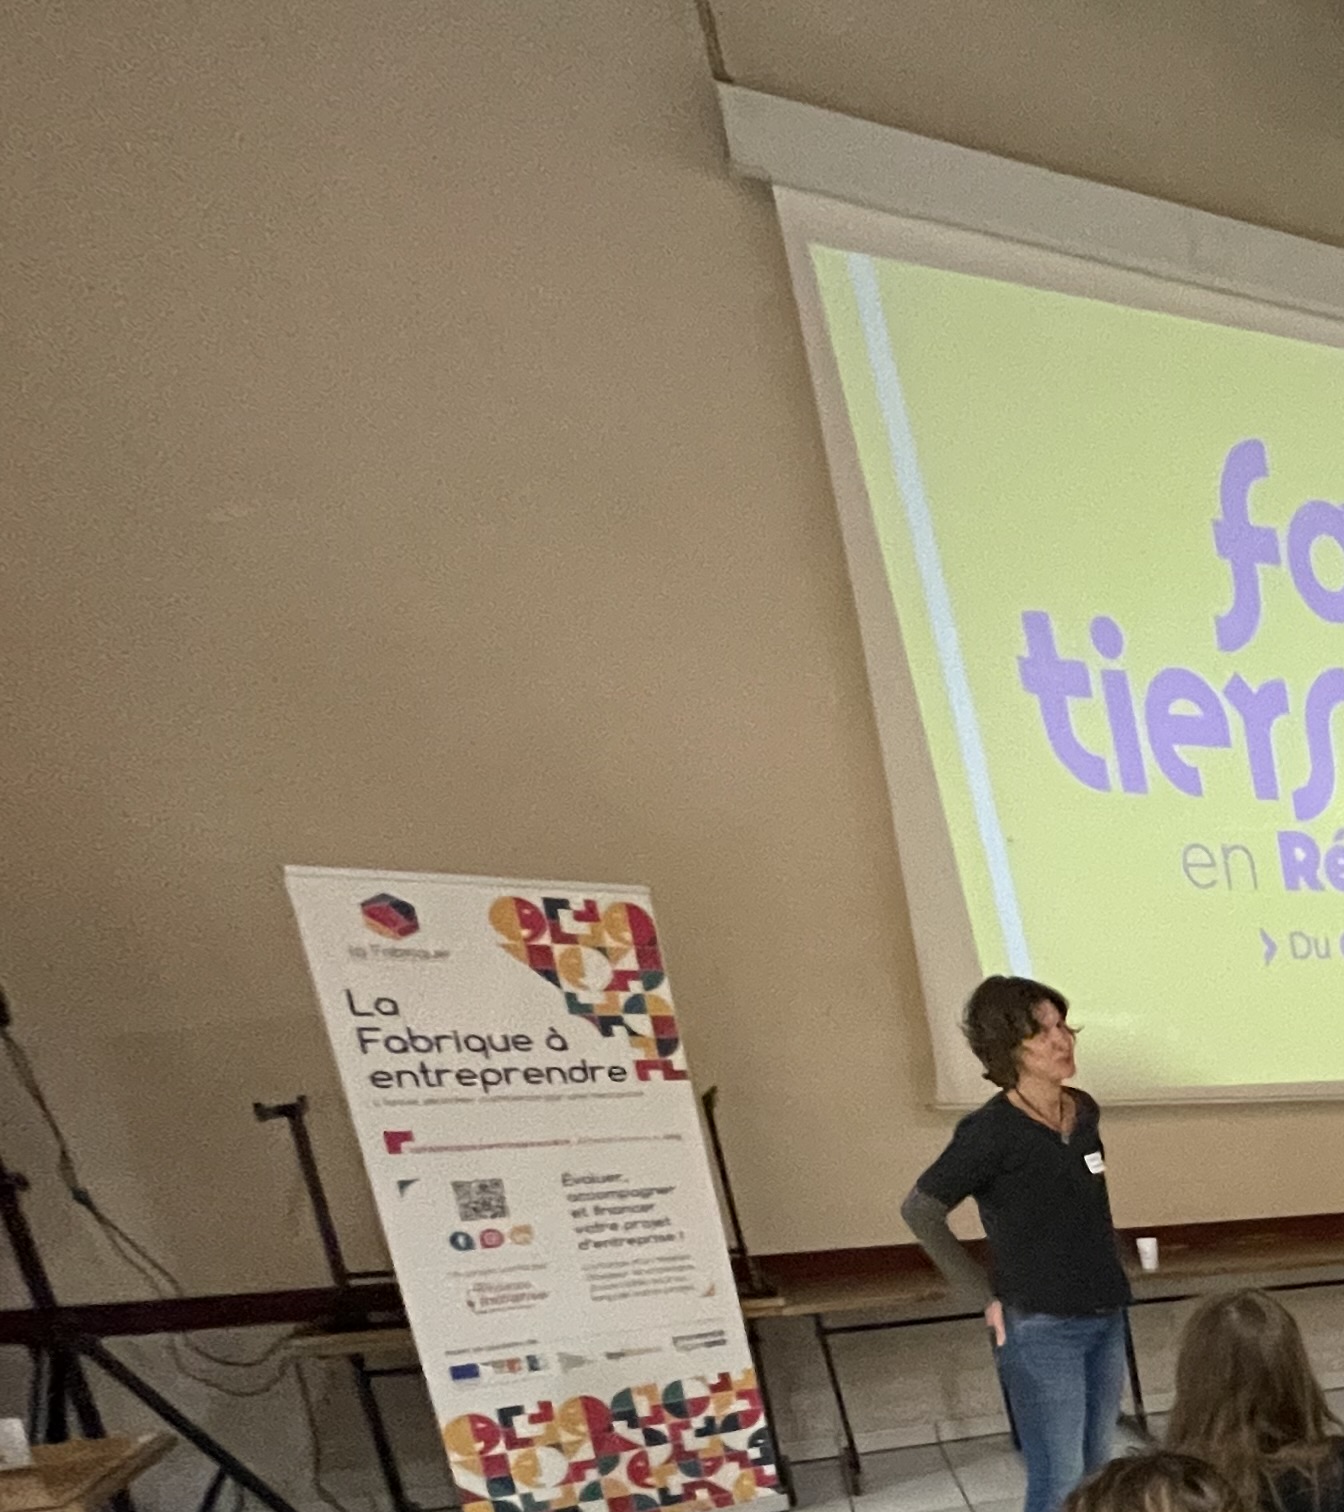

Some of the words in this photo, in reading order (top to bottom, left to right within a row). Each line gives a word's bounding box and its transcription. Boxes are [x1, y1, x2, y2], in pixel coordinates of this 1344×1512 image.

[1181, 843, 1258, 891] en
[1289, 931, 1331, 960] Du
[345, 988, 400, 1017] La
[355, 1026, 534, 1060] Fabrique
[544, 1026, 570, 1052] à
[369, 1059, 628, 1094] entreprendre
